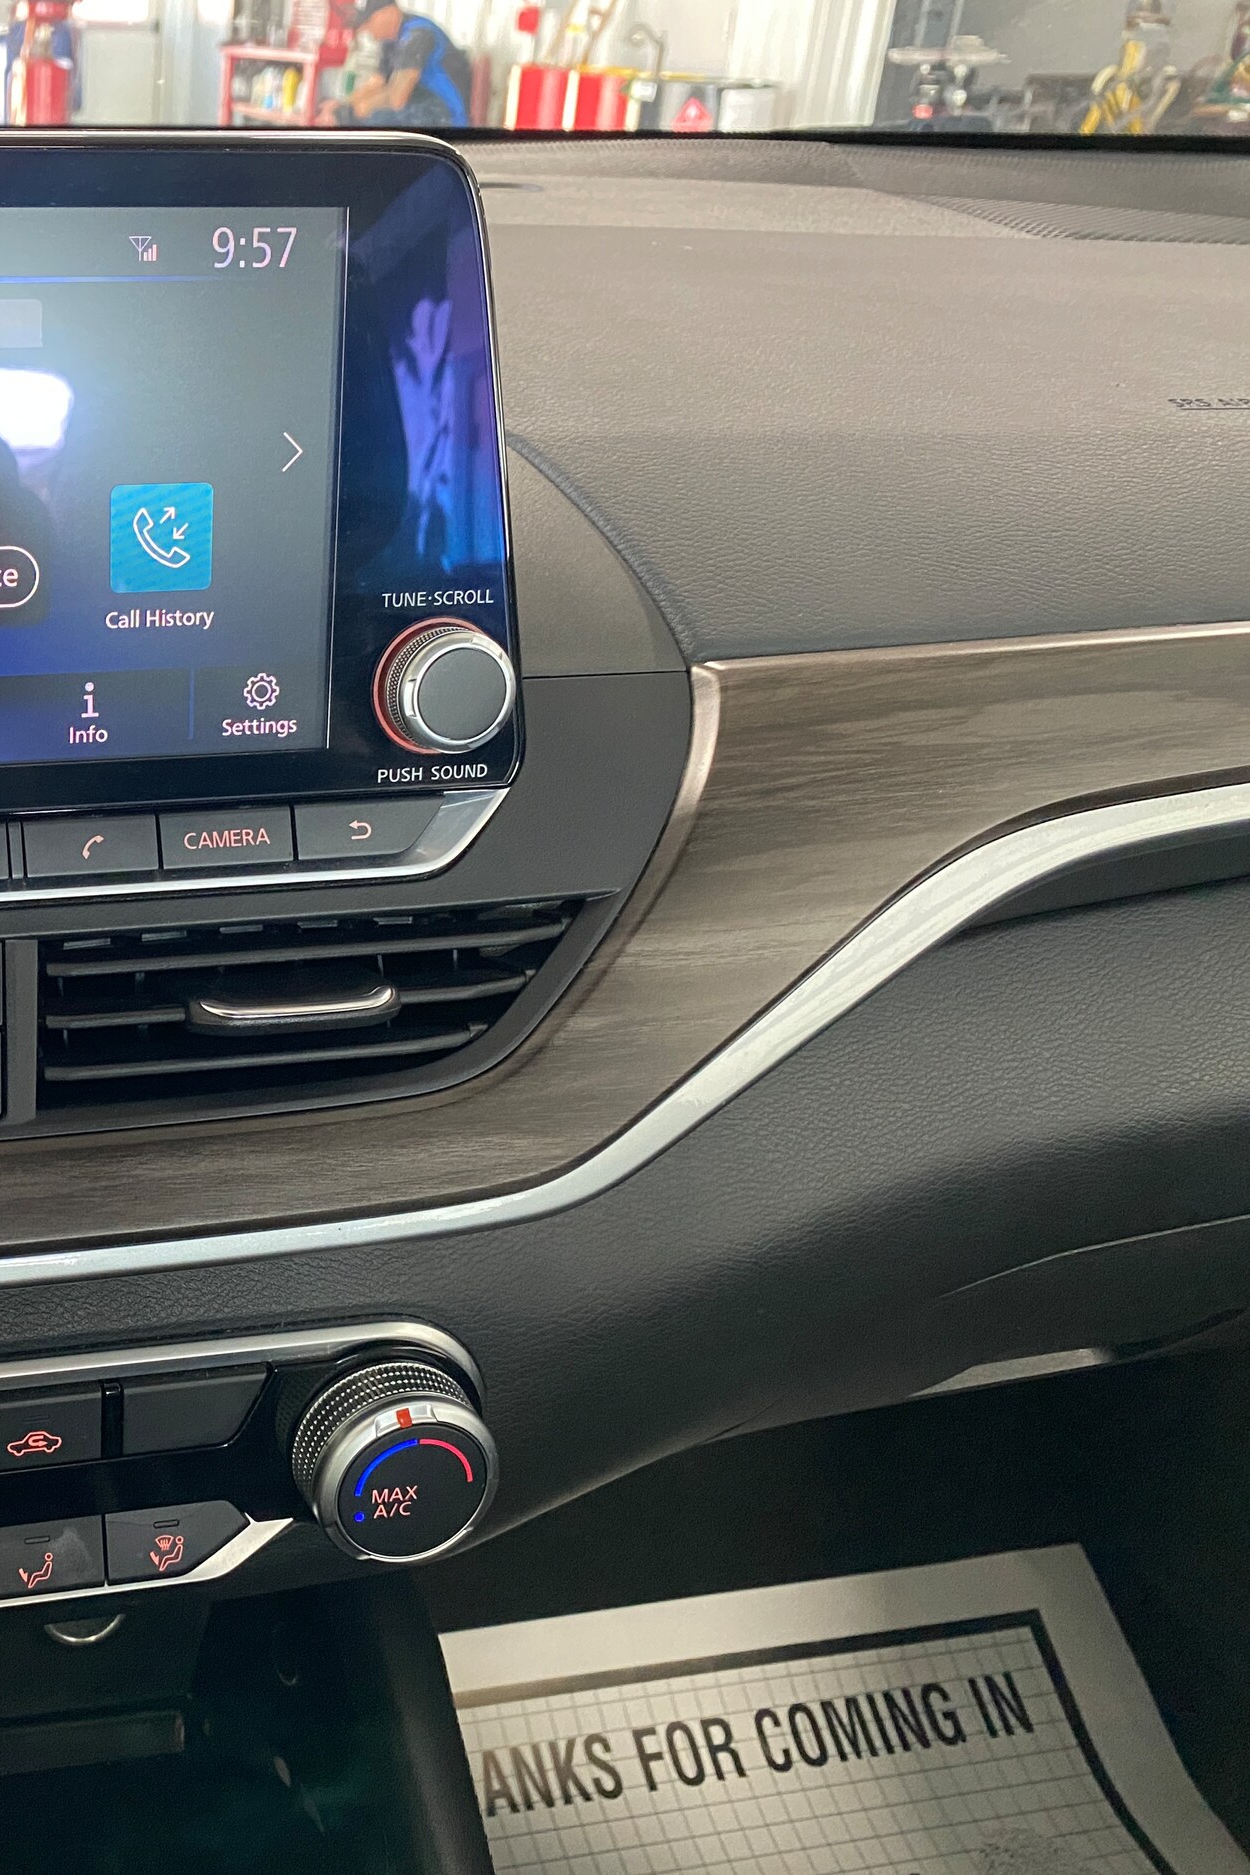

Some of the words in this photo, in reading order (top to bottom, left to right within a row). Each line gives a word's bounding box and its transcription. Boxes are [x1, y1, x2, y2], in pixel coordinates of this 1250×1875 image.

[211, 226, 299, 270] 9:57
[105, 611, 139, 629] Call
[146, 609, 214, 629] History
[68, 725, 108, 744] Info
[221, 717, 298, 737] Settings
[377, 767, 423, 784] PUSH
[431, 763, 488, 781] SOUND
[183, 827, 271, 850] CAMERA
[372, 1485, 418, 1503] MAX
[373, 1501, 412, 1519] A/C
[632, 1717, 747, 1792] FOR
[754, 1682, 967, 1773] COMING
[968, 1671, 1035, 1738] IN
